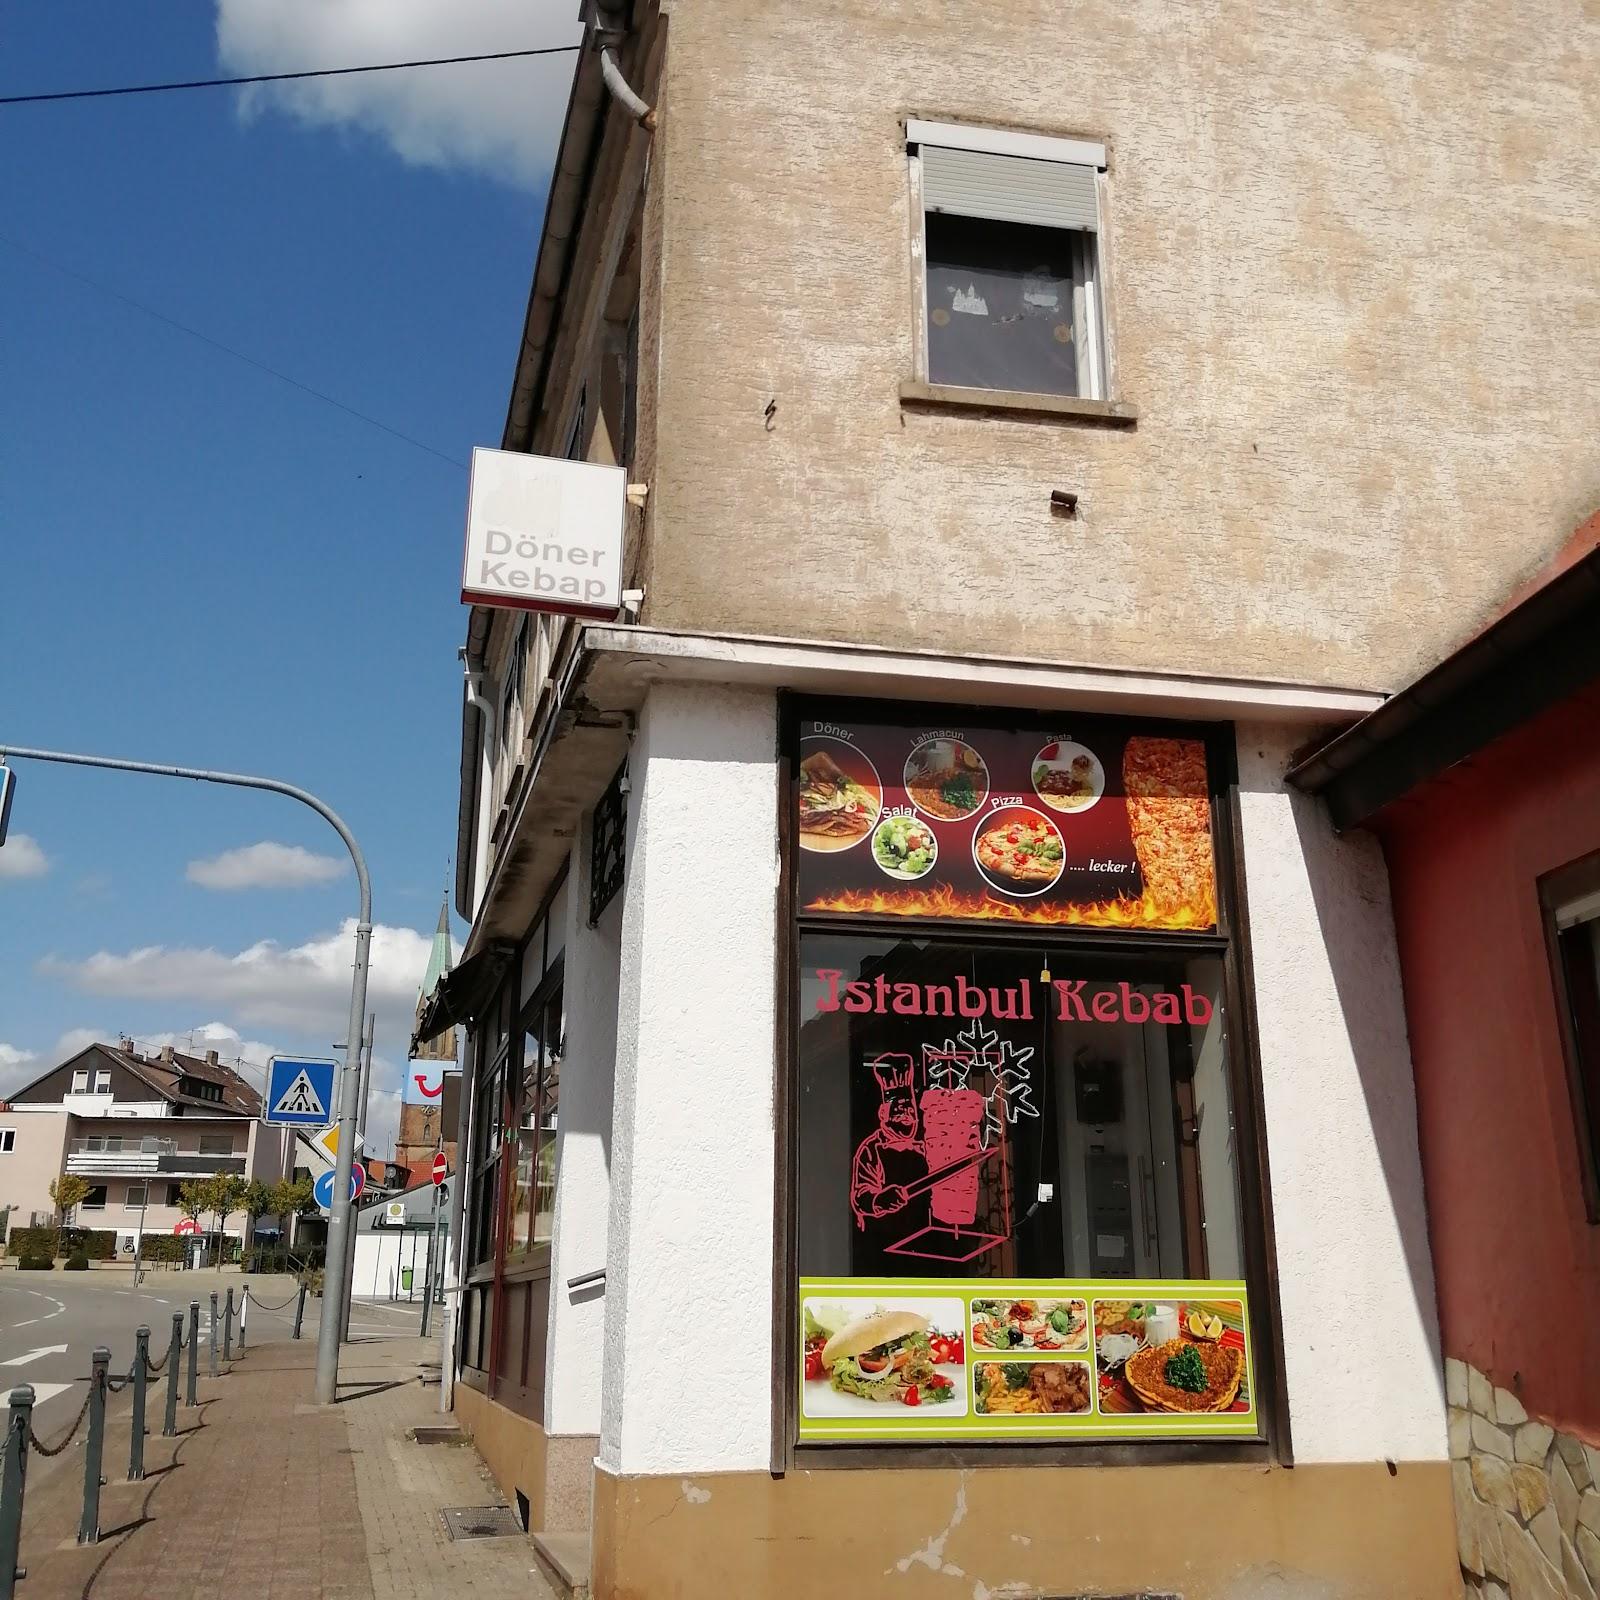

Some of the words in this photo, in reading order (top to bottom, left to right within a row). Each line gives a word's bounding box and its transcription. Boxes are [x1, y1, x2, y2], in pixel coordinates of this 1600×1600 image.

[485, 530, 606, 567] Döner
[480, 560, 606, 602] Kebap
[813, 721, 854, 741] Döner
[910, 729, 964, 747] Lahmacun
[1046, 733, 1072, 744] Pasta
[881, 804, 918, 818] Salat
[991, 796, 1023, 809] Pizza
[1088, 858, 1128, 873] lecker
[1052, 979, 1213, 1025] Kebab
